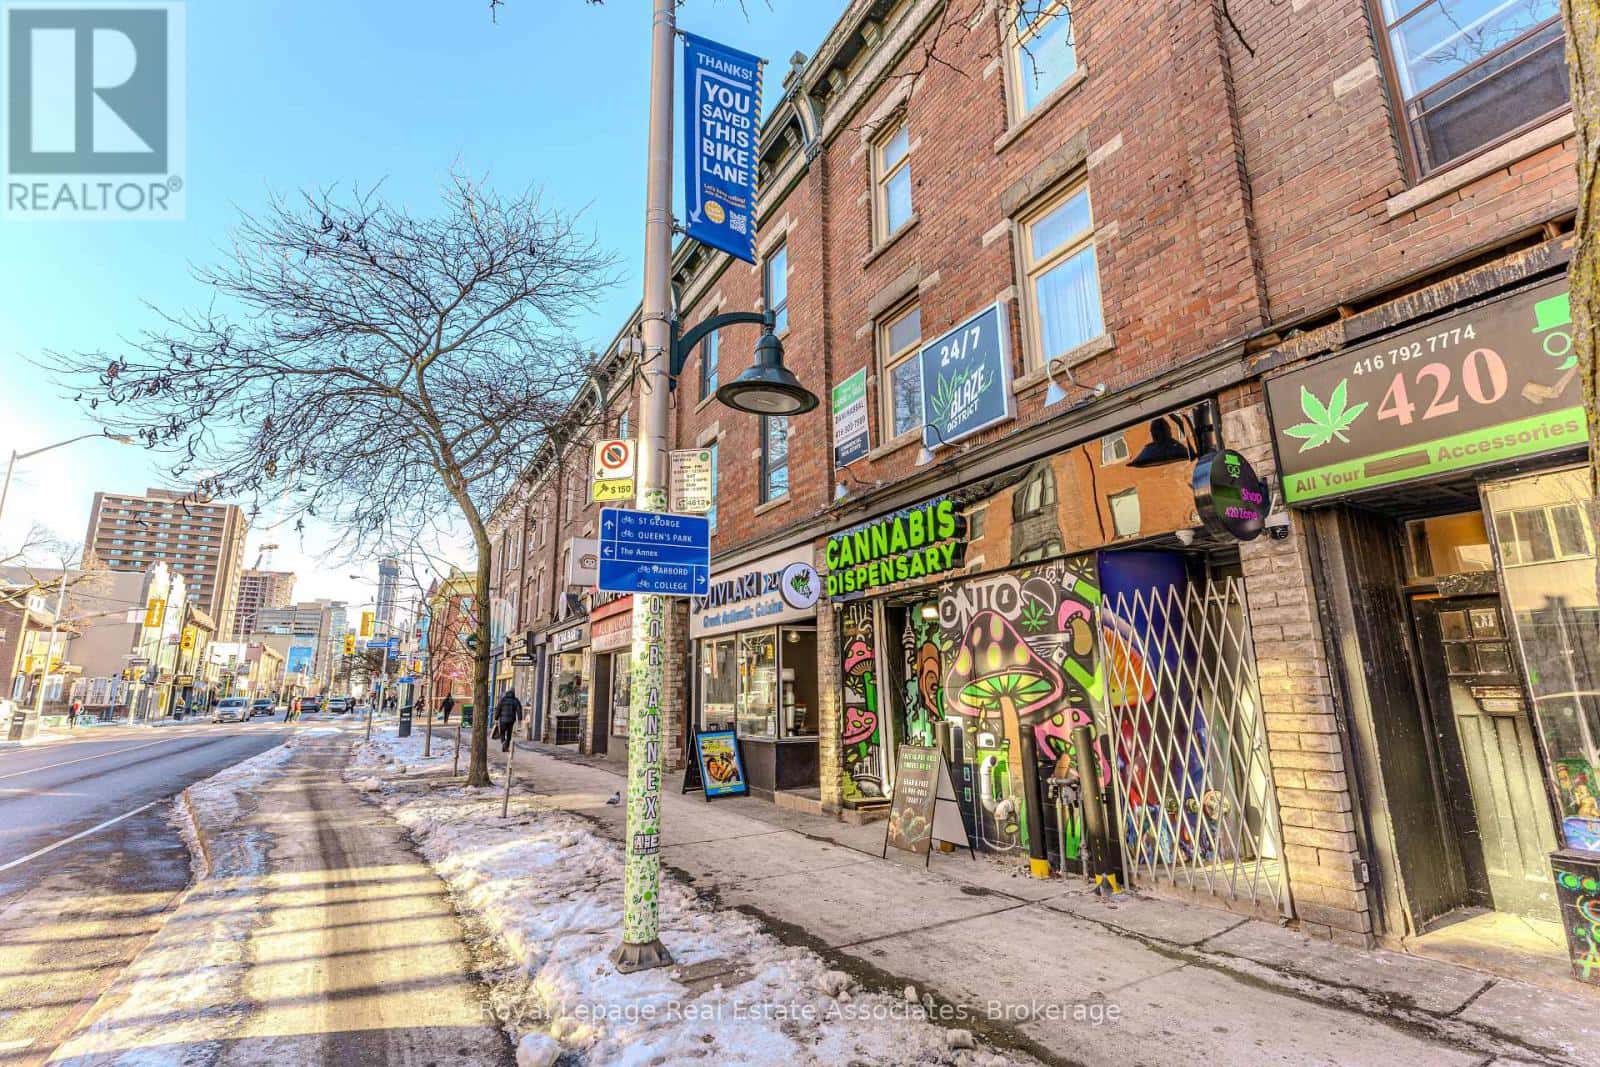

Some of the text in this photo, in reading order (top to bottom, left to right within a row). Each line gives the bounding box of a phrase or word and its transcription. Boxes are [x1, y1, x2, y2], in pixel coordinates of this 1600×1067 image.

[697, 52, 753, 81] THANKS!
[704, 80, 750, 114] YOU
[702, 103, 750, 129] SAVED
[702, 118, 749, 148] THIS
[703, 137, 749, 169] BIKE
[703, 156, 749, 186] LANE
[941, 325, 981, 368] 24/7
[1353, 324, 1476, 375] 416 792 7774
[1377, 348, 1508, 426] 420
[947, 397, 979, 433] DISTRICT
[1295, 417, 1579, 493] All Your Accessories
[1241, 488, 1262, 504] Shop
[638, 517, 680, 528] ST GEORGE
[638, 531, 692, 543] QUEEN'S PARK
[826, 500, 955, 570] CANNABIS
[621, 547, 658, 557] The Annex
[654, 581, 688, 590] COLLEGE
[827, 542, 956, 596] DISPENSARY
[649, 594, 660, 666] OOR
[645, 687, 659, 820] ANNEX
